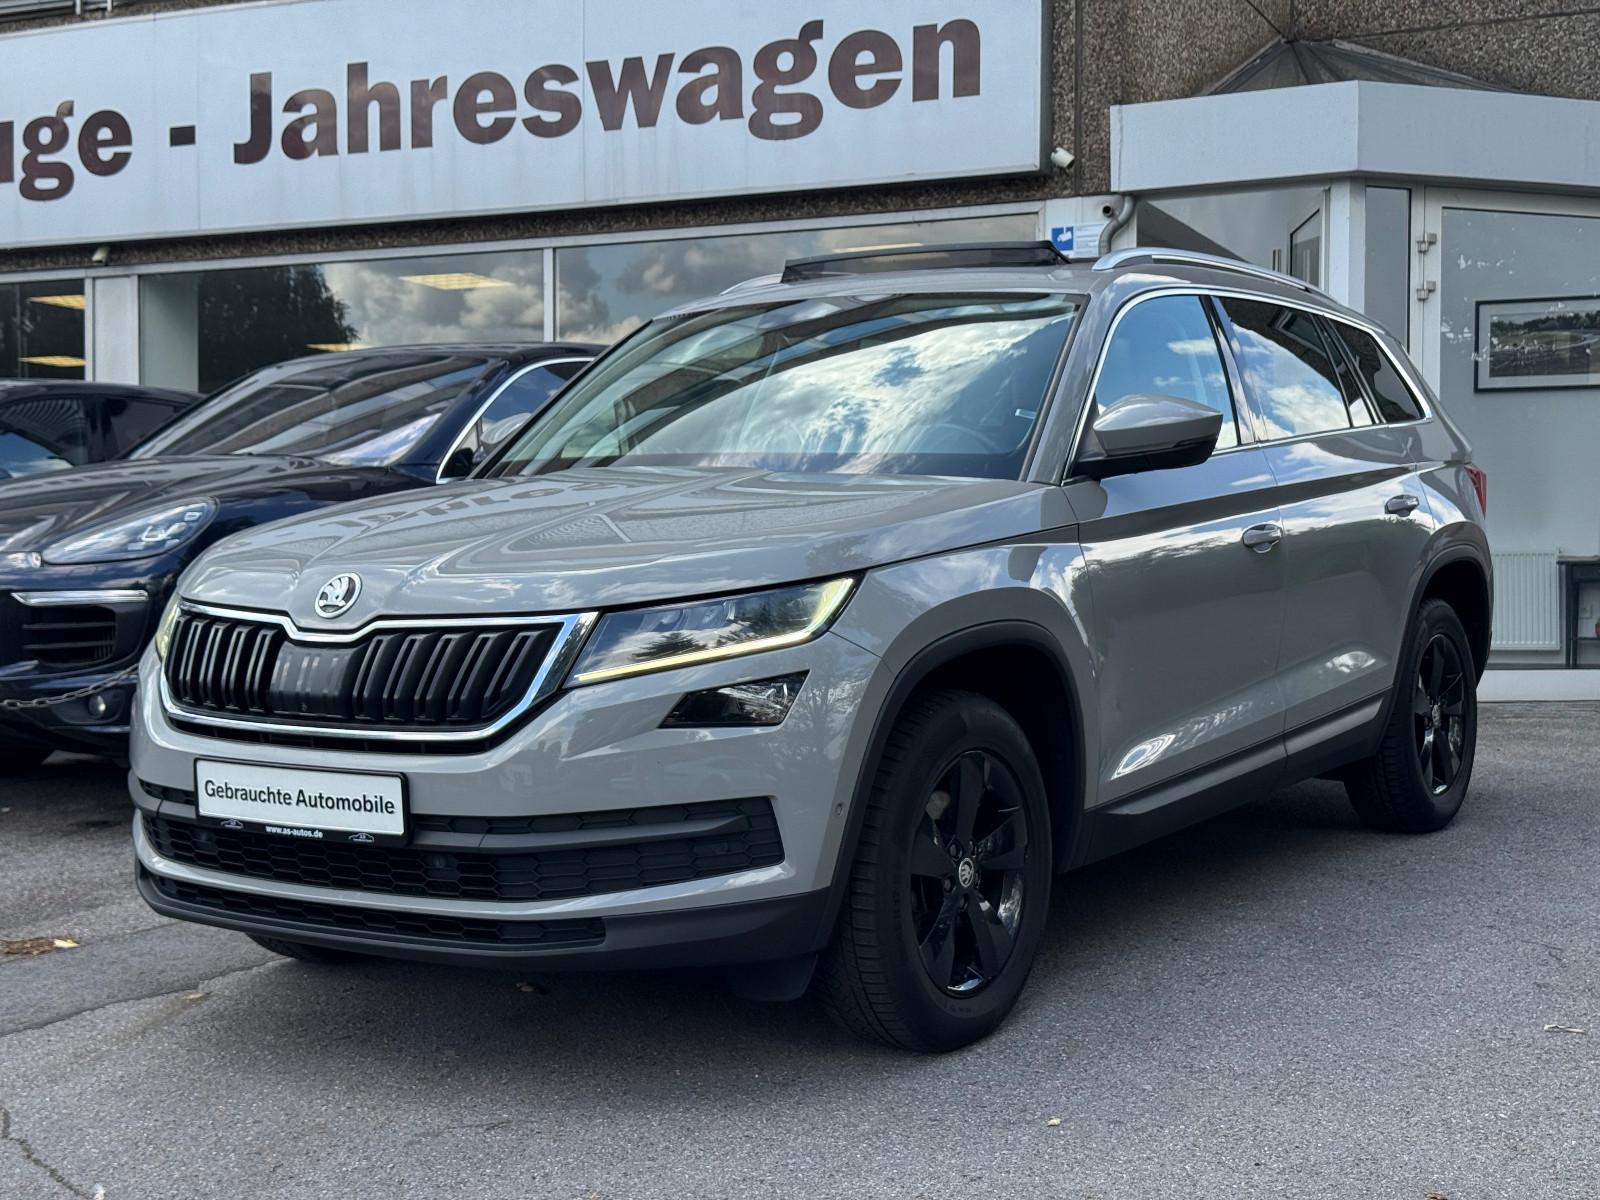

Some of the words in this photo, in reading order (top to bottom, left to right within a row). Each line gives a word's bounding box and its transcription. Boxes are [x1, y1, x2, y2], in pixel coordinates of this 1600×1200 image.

[0, 100, 133, 202] ge
[169, 125, 196, 147] -
[234, 18, 981, 165] Jahreswagen
[204, 779, 292, 806] Gebrauchte
[296, 789, 395, 815] Automobile
[265, 825, 324, 839] www.as-autos.de
